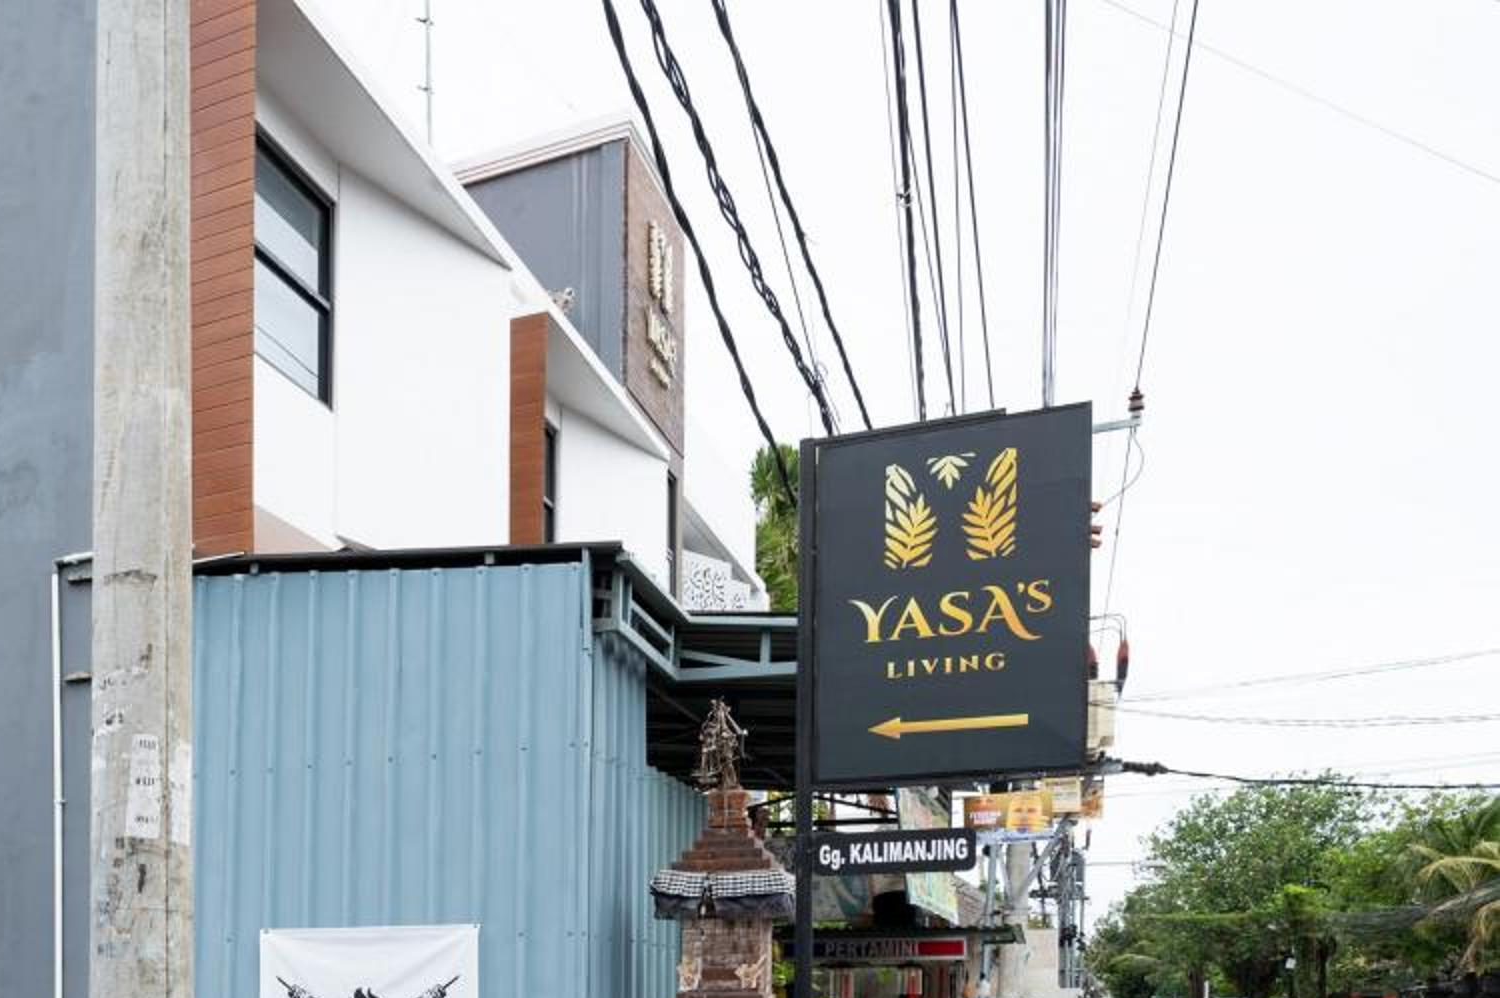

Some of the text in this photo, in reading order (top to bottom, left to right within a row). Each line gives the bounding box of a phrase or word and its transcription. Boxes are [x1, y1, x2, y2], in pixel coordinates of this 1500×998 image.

[848, 578, 1053, 644] YASA'S
[887, 653, 1006, 680] LIVING
[819, 837, 969, 871] Gg. KALIMANJING
[824, 940, 918, 958] PERTAMINI
